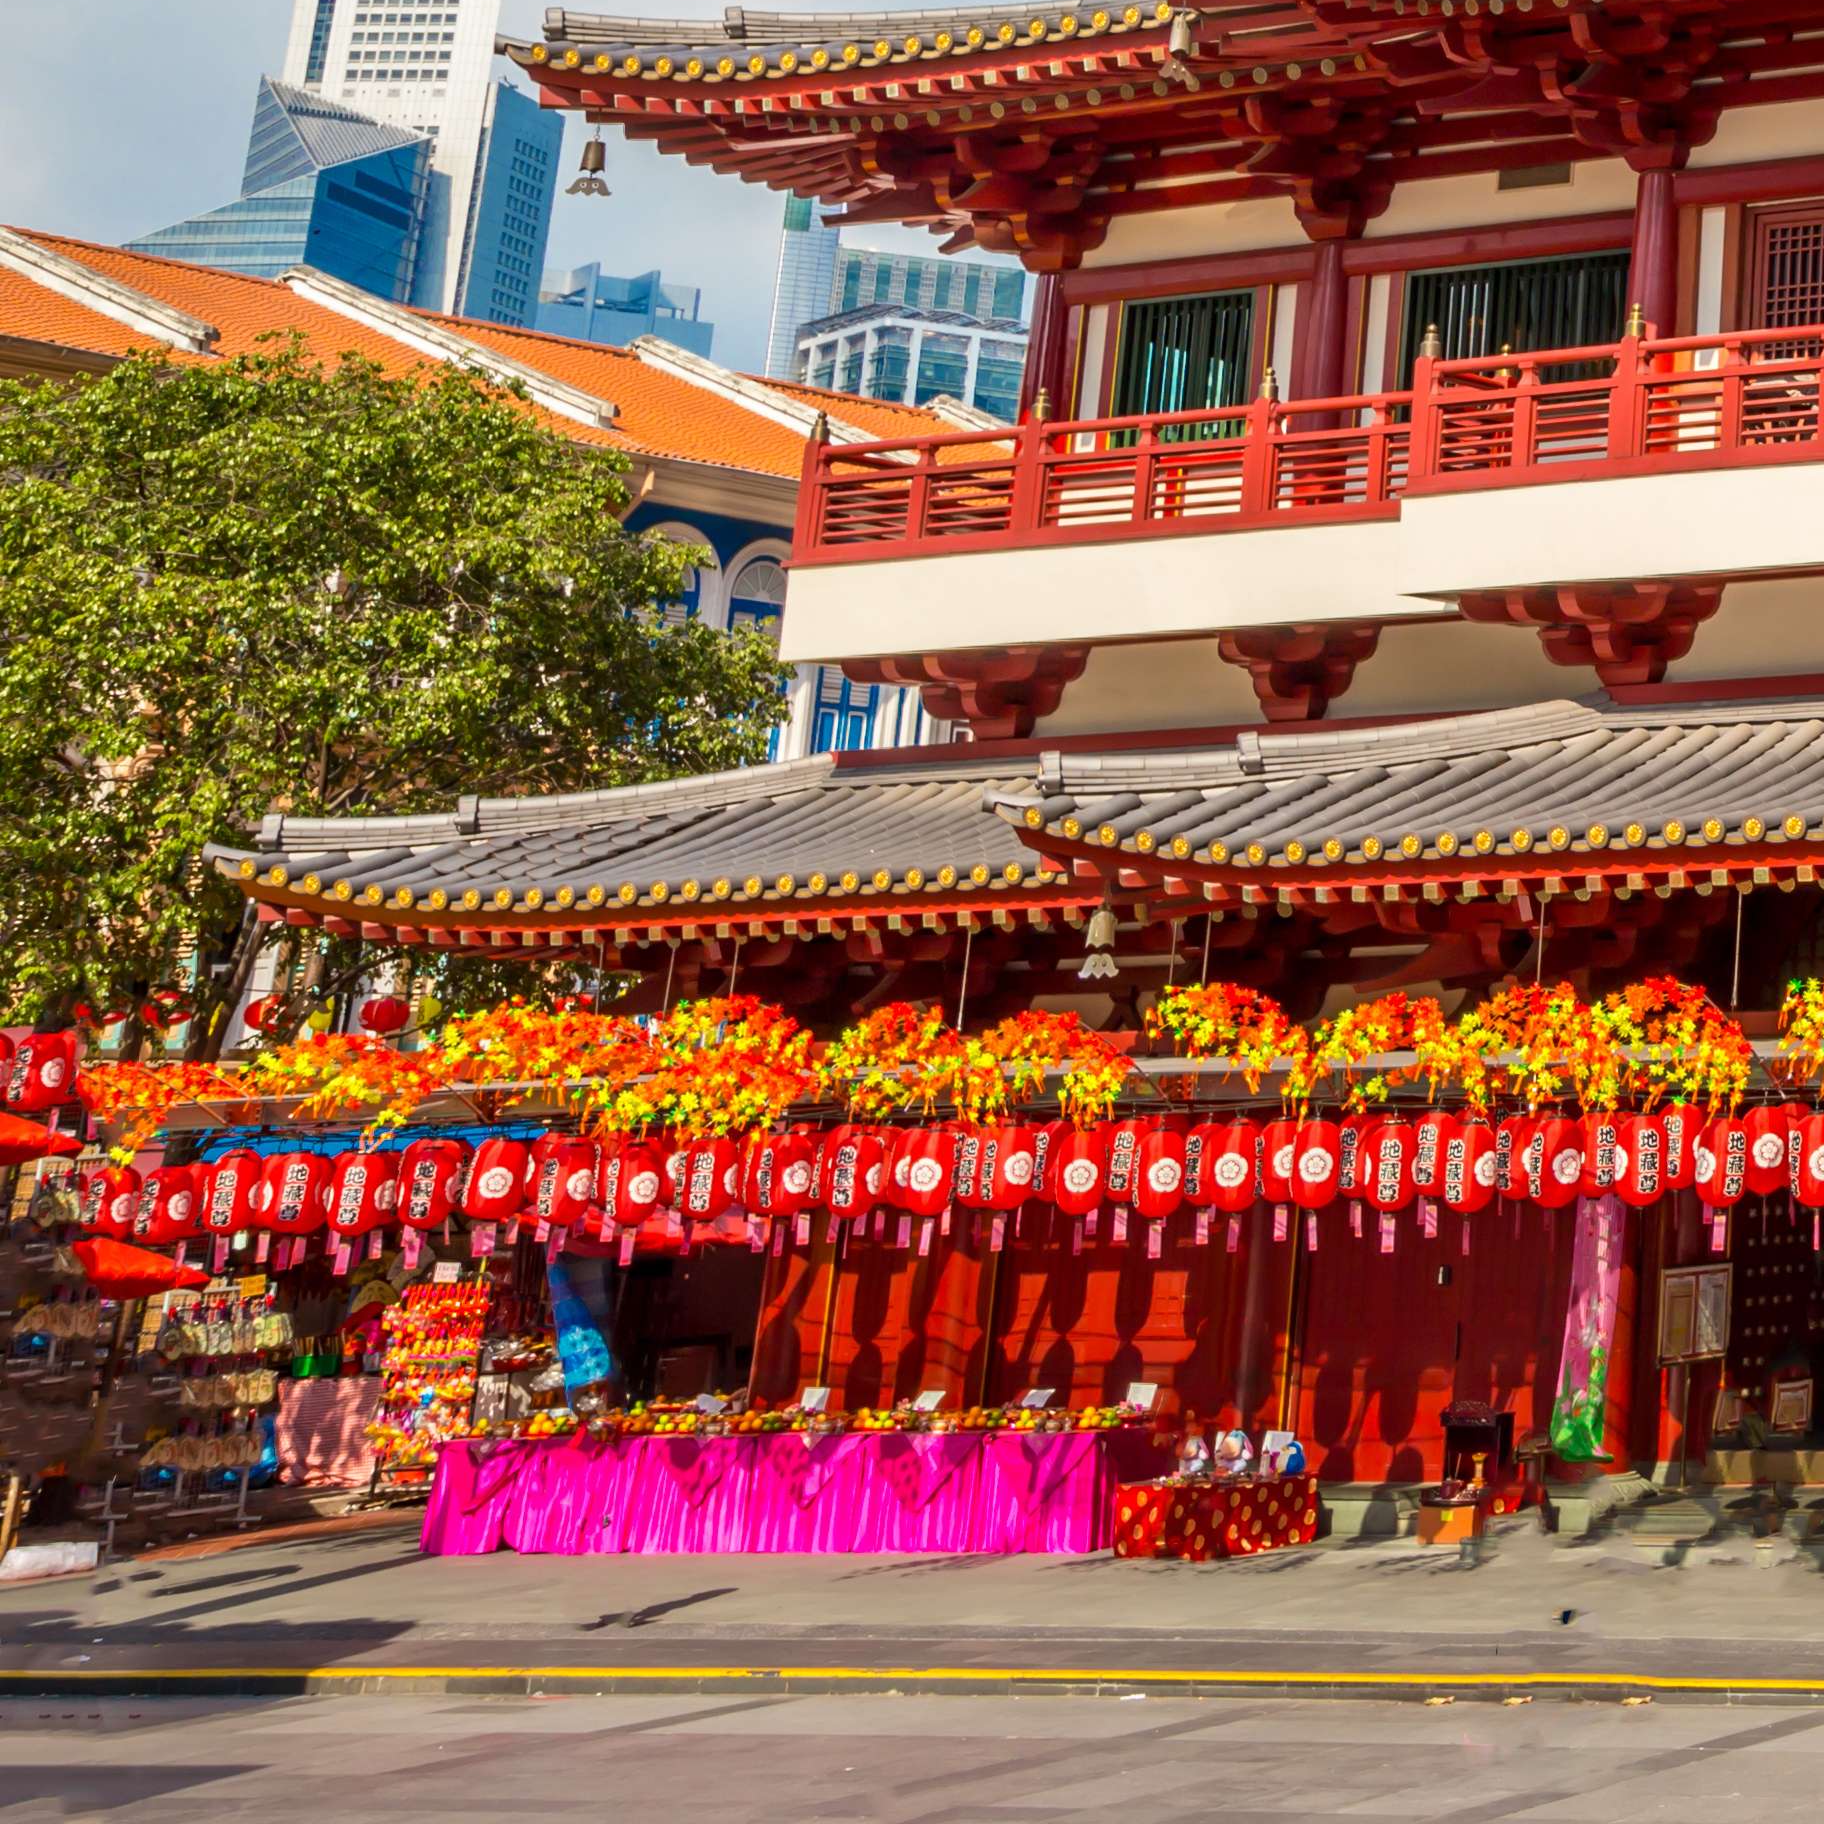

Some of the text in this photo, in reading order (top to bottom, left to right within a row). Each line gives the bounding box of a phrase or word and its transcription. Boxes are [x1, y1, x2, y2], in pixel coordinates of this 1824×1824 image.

[958, 1137, 979, 1197] 地藏尊
[1110, 1132, 1134, 1190] 地藏尊
[1185, 1136, 1201, 1195] 地藏尊
[1340, 1128, 1356, 1188] 地藏尊
[1378, 1140, 1401, 1202] 地藏尊
[1416, 1124, 1436, 1184] 地藏尊
[1446, 1140, 1464, 1202] 地藏尊
[1597, 1126, 1615, 1186] 地藏尊
[1638, 1130, 1658, 1193] 地藏尊
[1664, 1116, 1682, 1176] 地藏尊
[1724, 1131, 1745, 1195] 地藏尊
[211, 1170, 235, 1226] 地藏尊
[279, 1164, 309, 1221] 地藏尊
[337, 1167, 366, 1224] 地藏尊
[409, 1160, 436, 1219] 地藏尊
[689, 1152, 714, 1211] 地藏尊
[833, 1146, 856, 1207] 地藏尊
